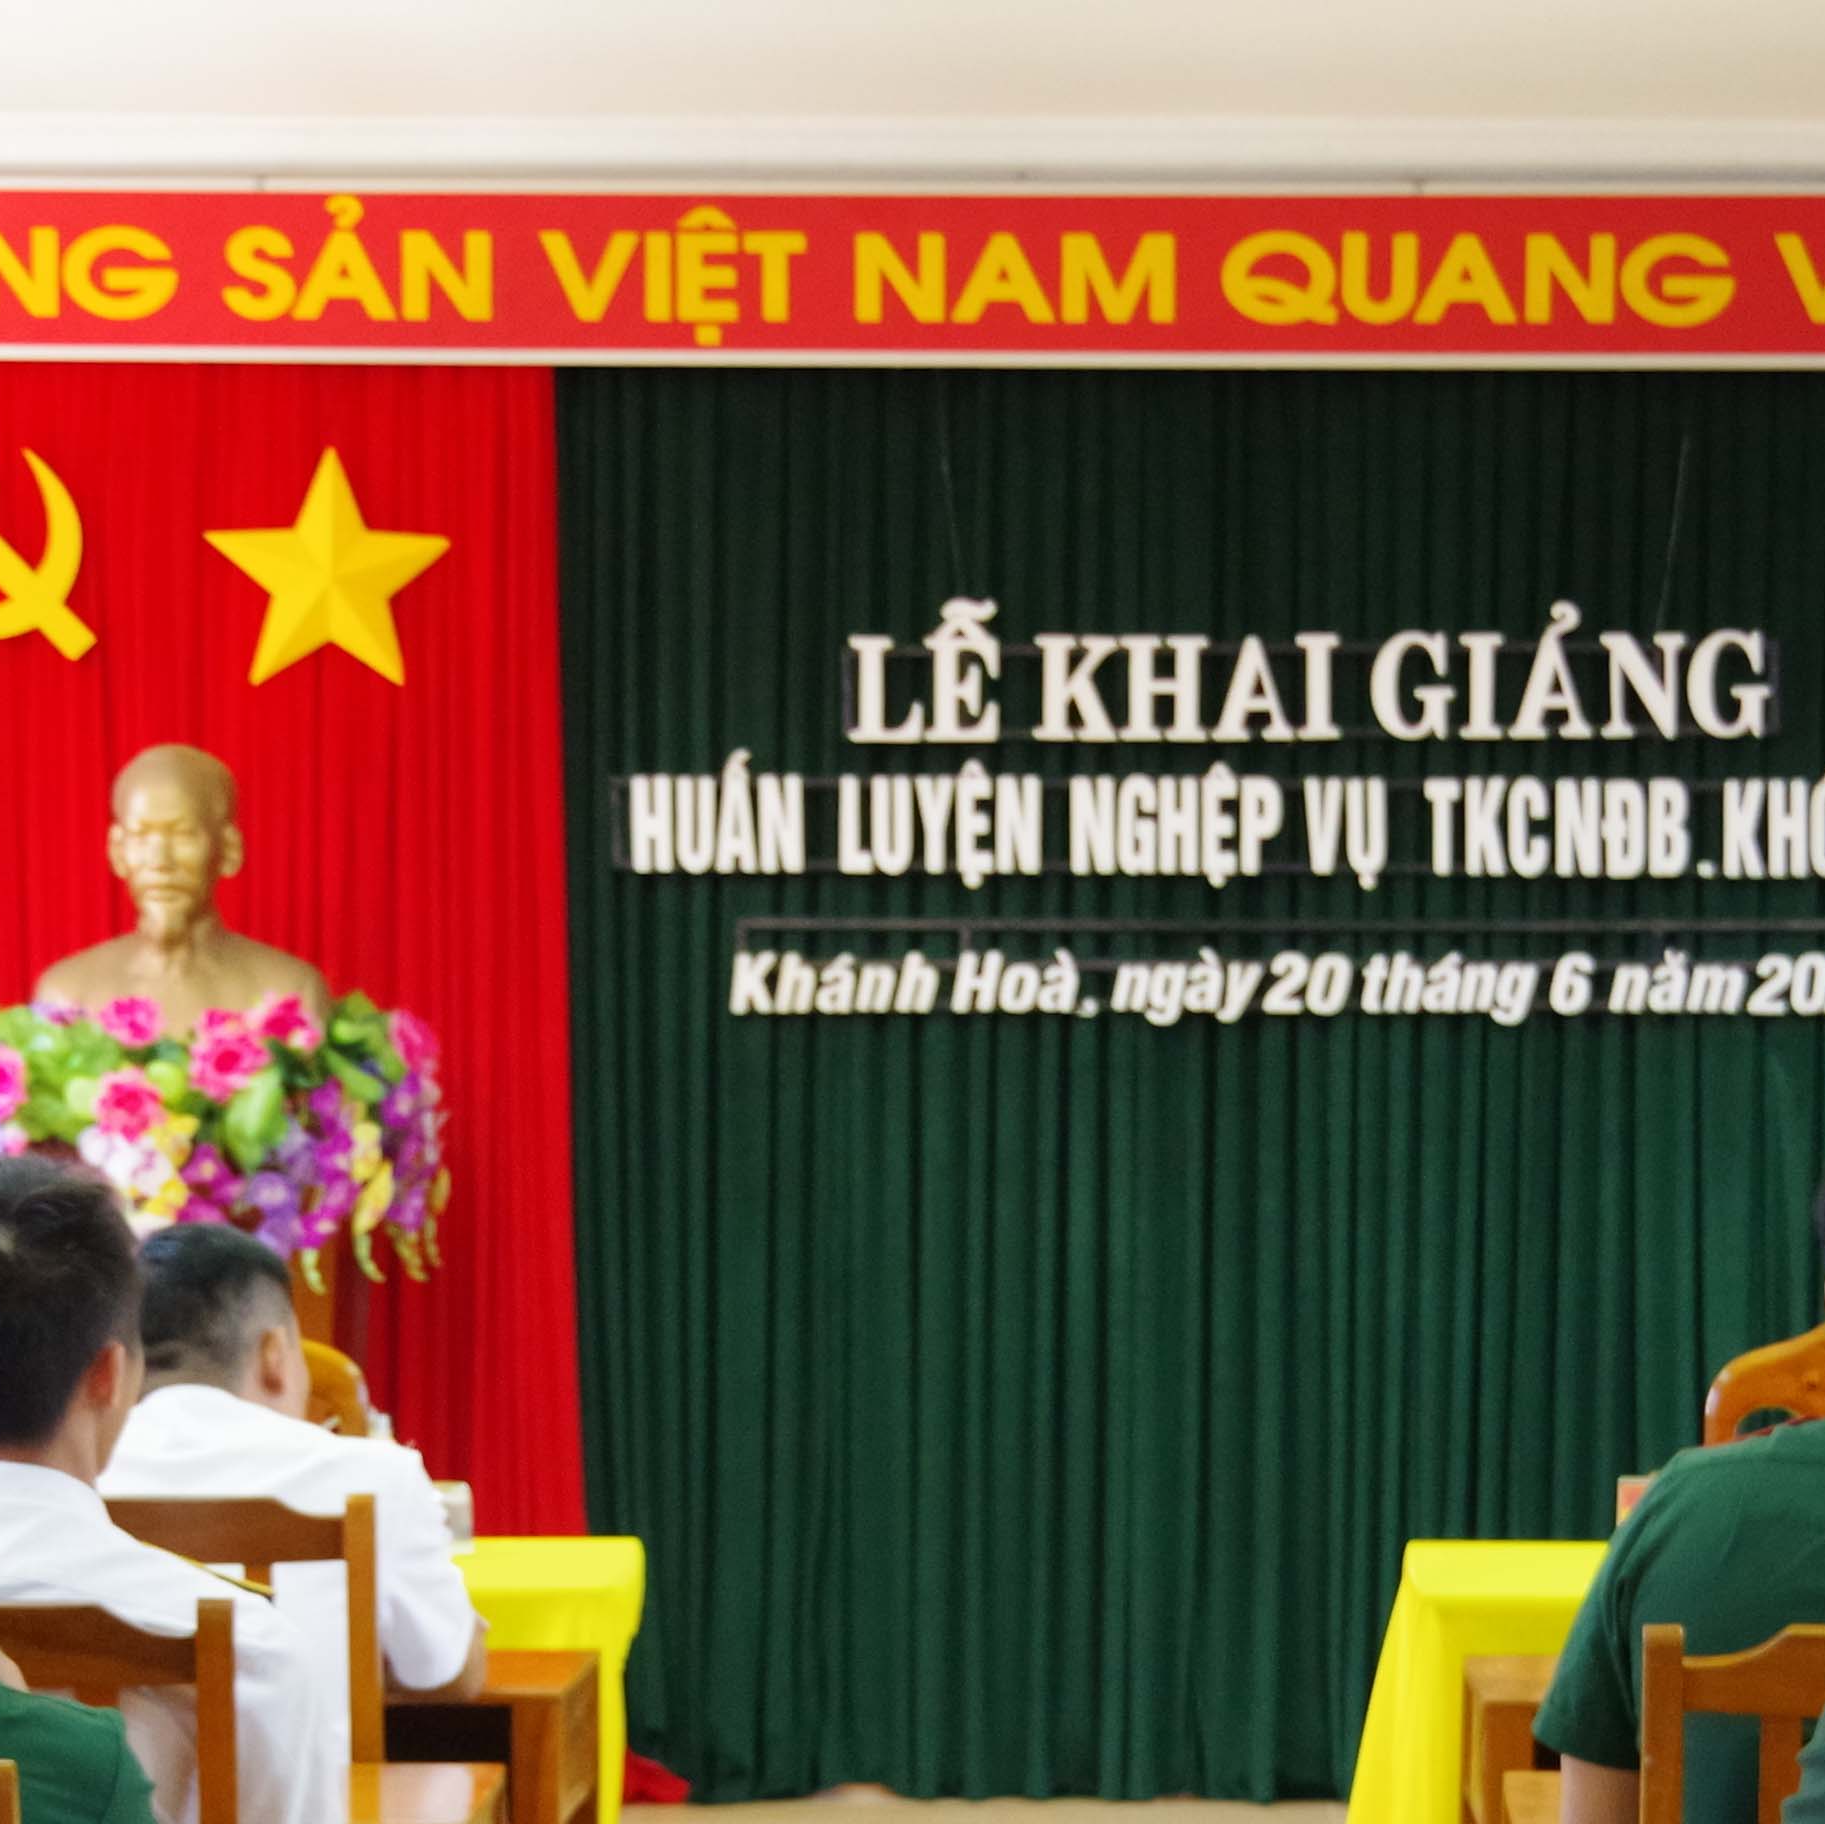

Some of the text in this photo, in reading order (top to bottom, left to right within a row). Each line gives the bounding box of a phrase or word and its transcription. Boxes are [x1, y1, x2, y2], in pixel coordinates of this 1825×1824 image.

[222, 193, 493, 320] SẢN
[539, 206, 807, 345] VIỆT
[854, 232, 1176, 323] NAM
[1220, 230, 1735, 325] QUANG
[847, 597, 1772, 742] LỄ KHAI GIẢNG
[628, 748, 805, 875] HUẤN
[837, 758, 1042, 888] LUYỆN
[1302, 774, 1388, 890] VỤ
[728, 949, 940, 1015] Khánh
[1109, 946, 1264, 1026] ngày
[1261, 950, 1352, 1016] 20
[1360, 950, 1538, 1025] tháng
[1549, 951, 1595, 1014] 6
[1608, 946, 1748, 1015] năm
